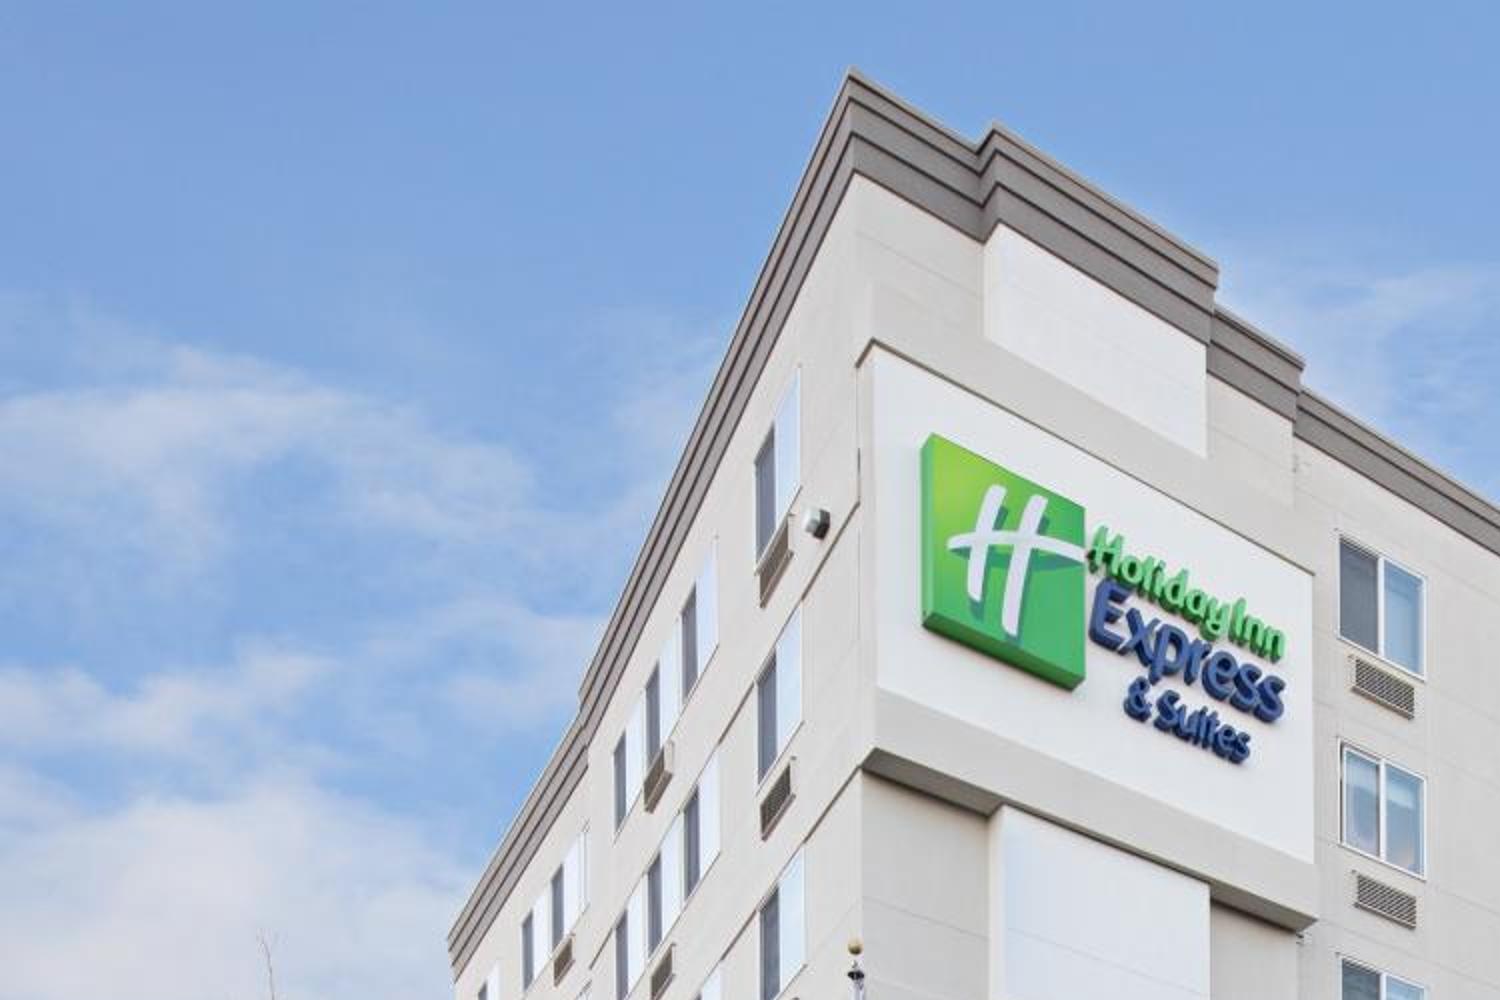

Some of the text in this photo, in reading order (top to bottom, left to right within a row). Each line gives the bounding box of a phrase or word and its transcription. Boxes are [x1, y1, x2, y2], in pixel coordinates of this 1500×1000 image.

[1088, 525, 1286, 662] Holiday Inn
[1089, 576, 1286, 722] Express
[1123, 676, 1251, 764] & Suites
